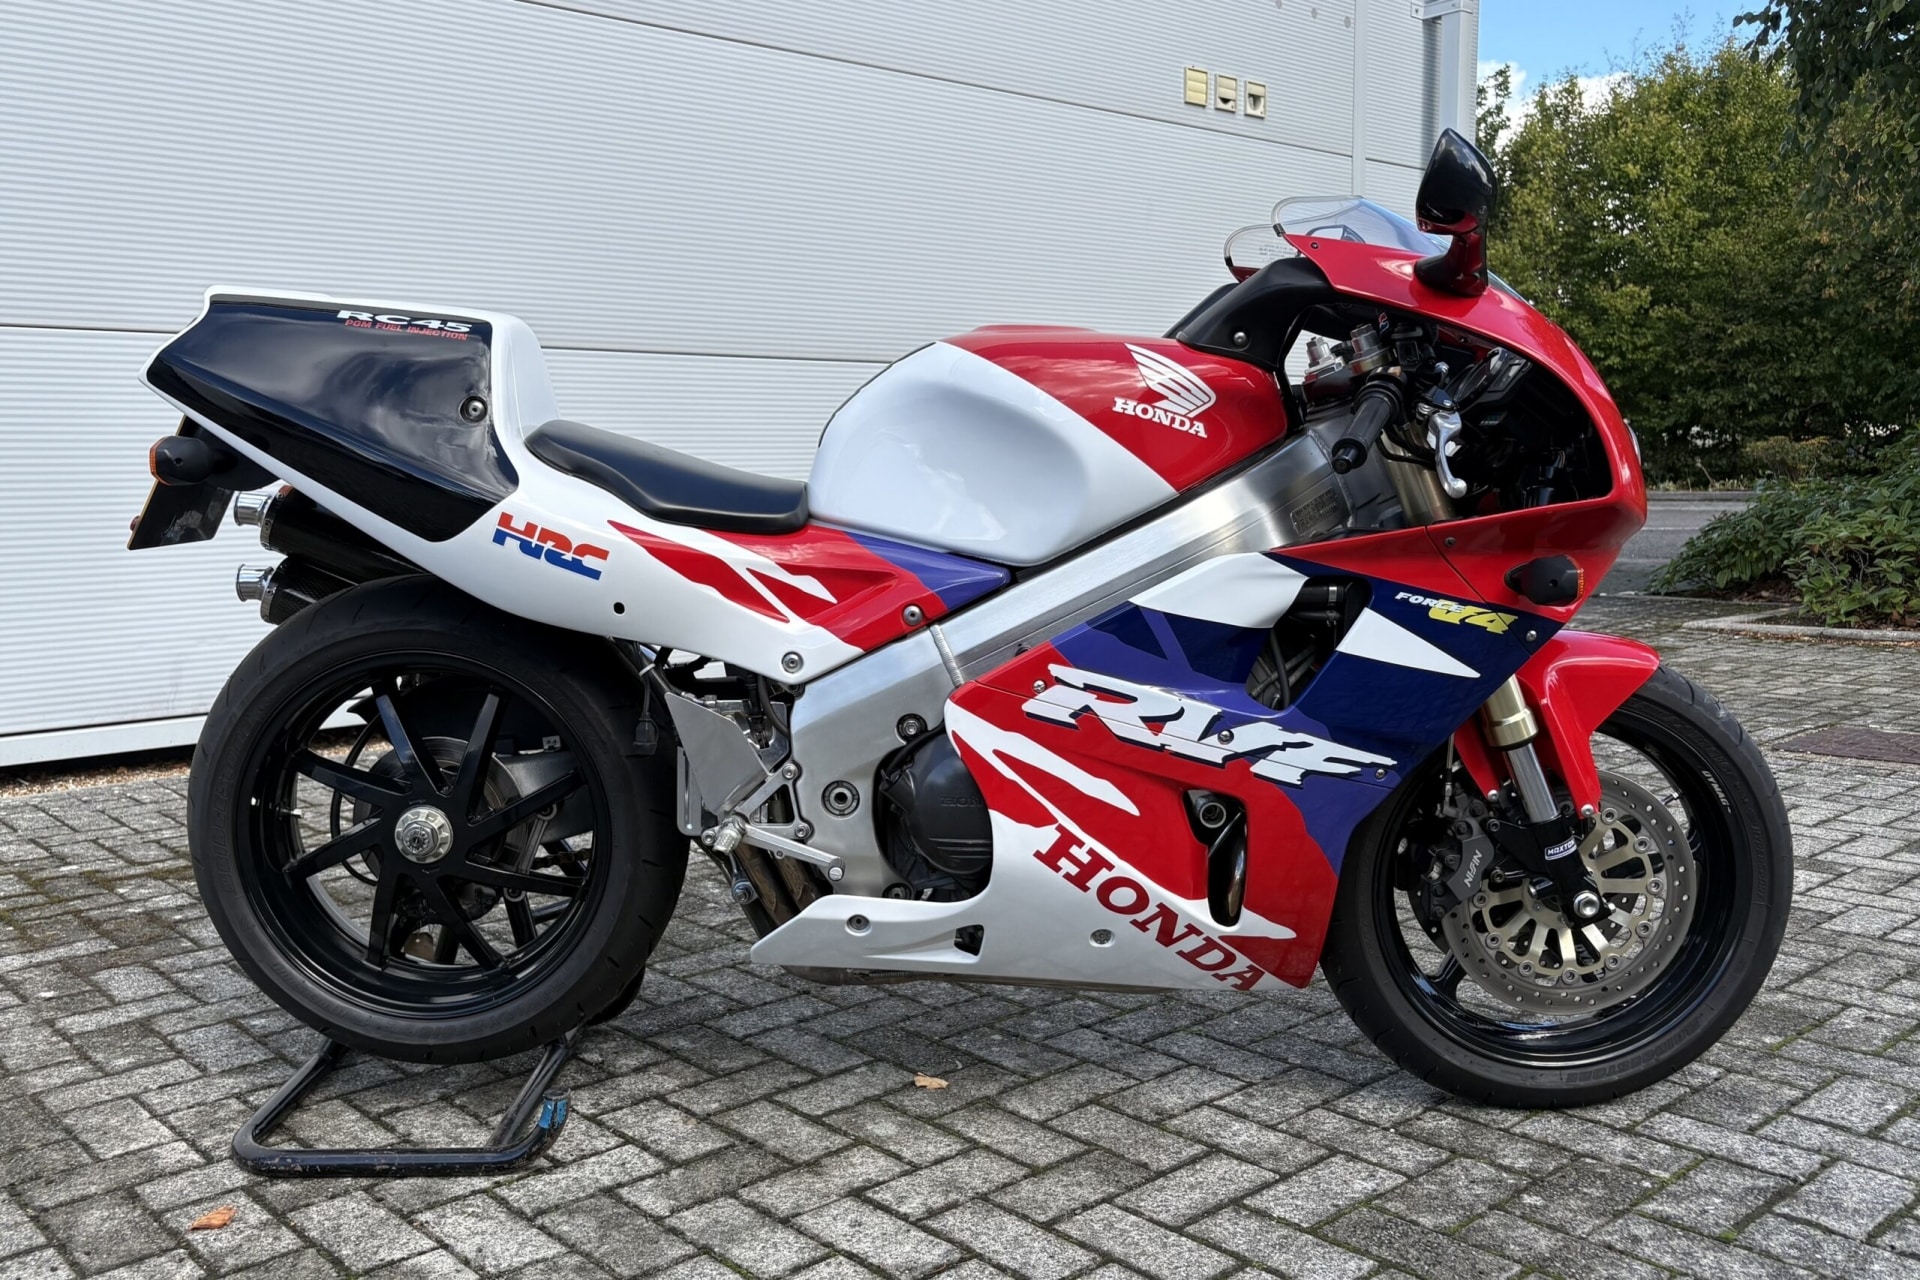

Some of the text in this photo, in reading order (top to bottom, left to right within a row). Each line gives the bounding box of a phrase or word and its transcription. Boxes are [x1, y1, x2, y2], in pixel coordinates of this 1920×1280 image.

[337, 310, 472, 333] RC45
[344, 319, 468, 341] PGM FUEL INJECTION
[1112, 397, 1208, 439] HONDA
[492, 511, 610, 581] HRC
[1395, 592, 1518, 635] FORCE V4
[1021, 663, 1398, 788] RVF
[1463, 848, 1483, 888] NISSIN
[1032, 823, 1266, 992] HONDA
